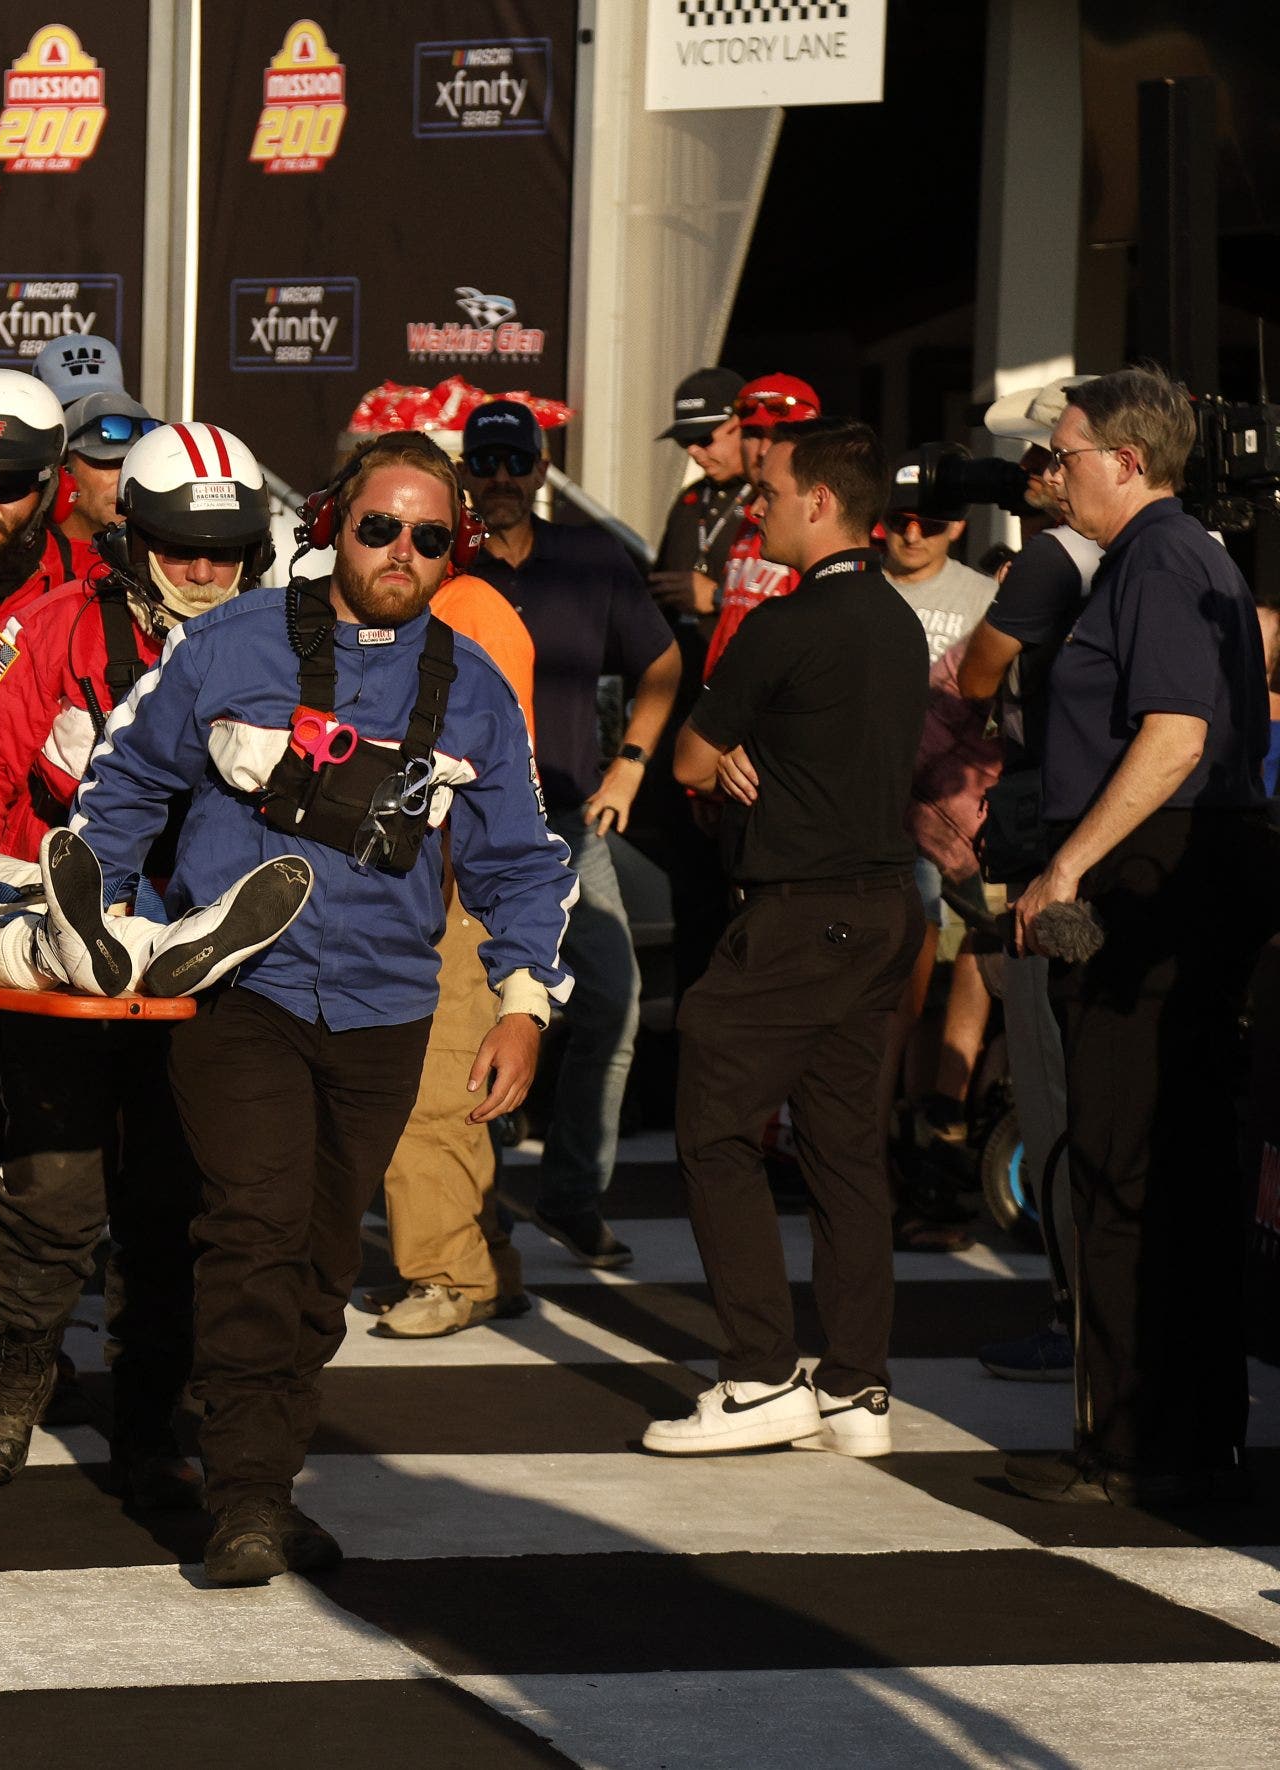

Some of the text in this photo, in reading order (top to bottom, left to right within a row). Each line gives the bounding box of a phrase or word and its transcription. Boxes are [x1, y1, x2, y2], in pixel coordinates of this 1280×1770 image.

[466, 47, 514, 66] NASCAR
[677, 31, 847, 66] VICTORY LANE
[435, 69, 528, 118] xfinity
[249, 104, 347, 160] 200
[461, 110, 502, 128] SERIES
[23, 281, 79, 300] NASCAR
[279, 286, 325, 304] NASCAR
[250, 306, 338, 353] xfinity
[407, 322, 545, 353] Watkins Glen
